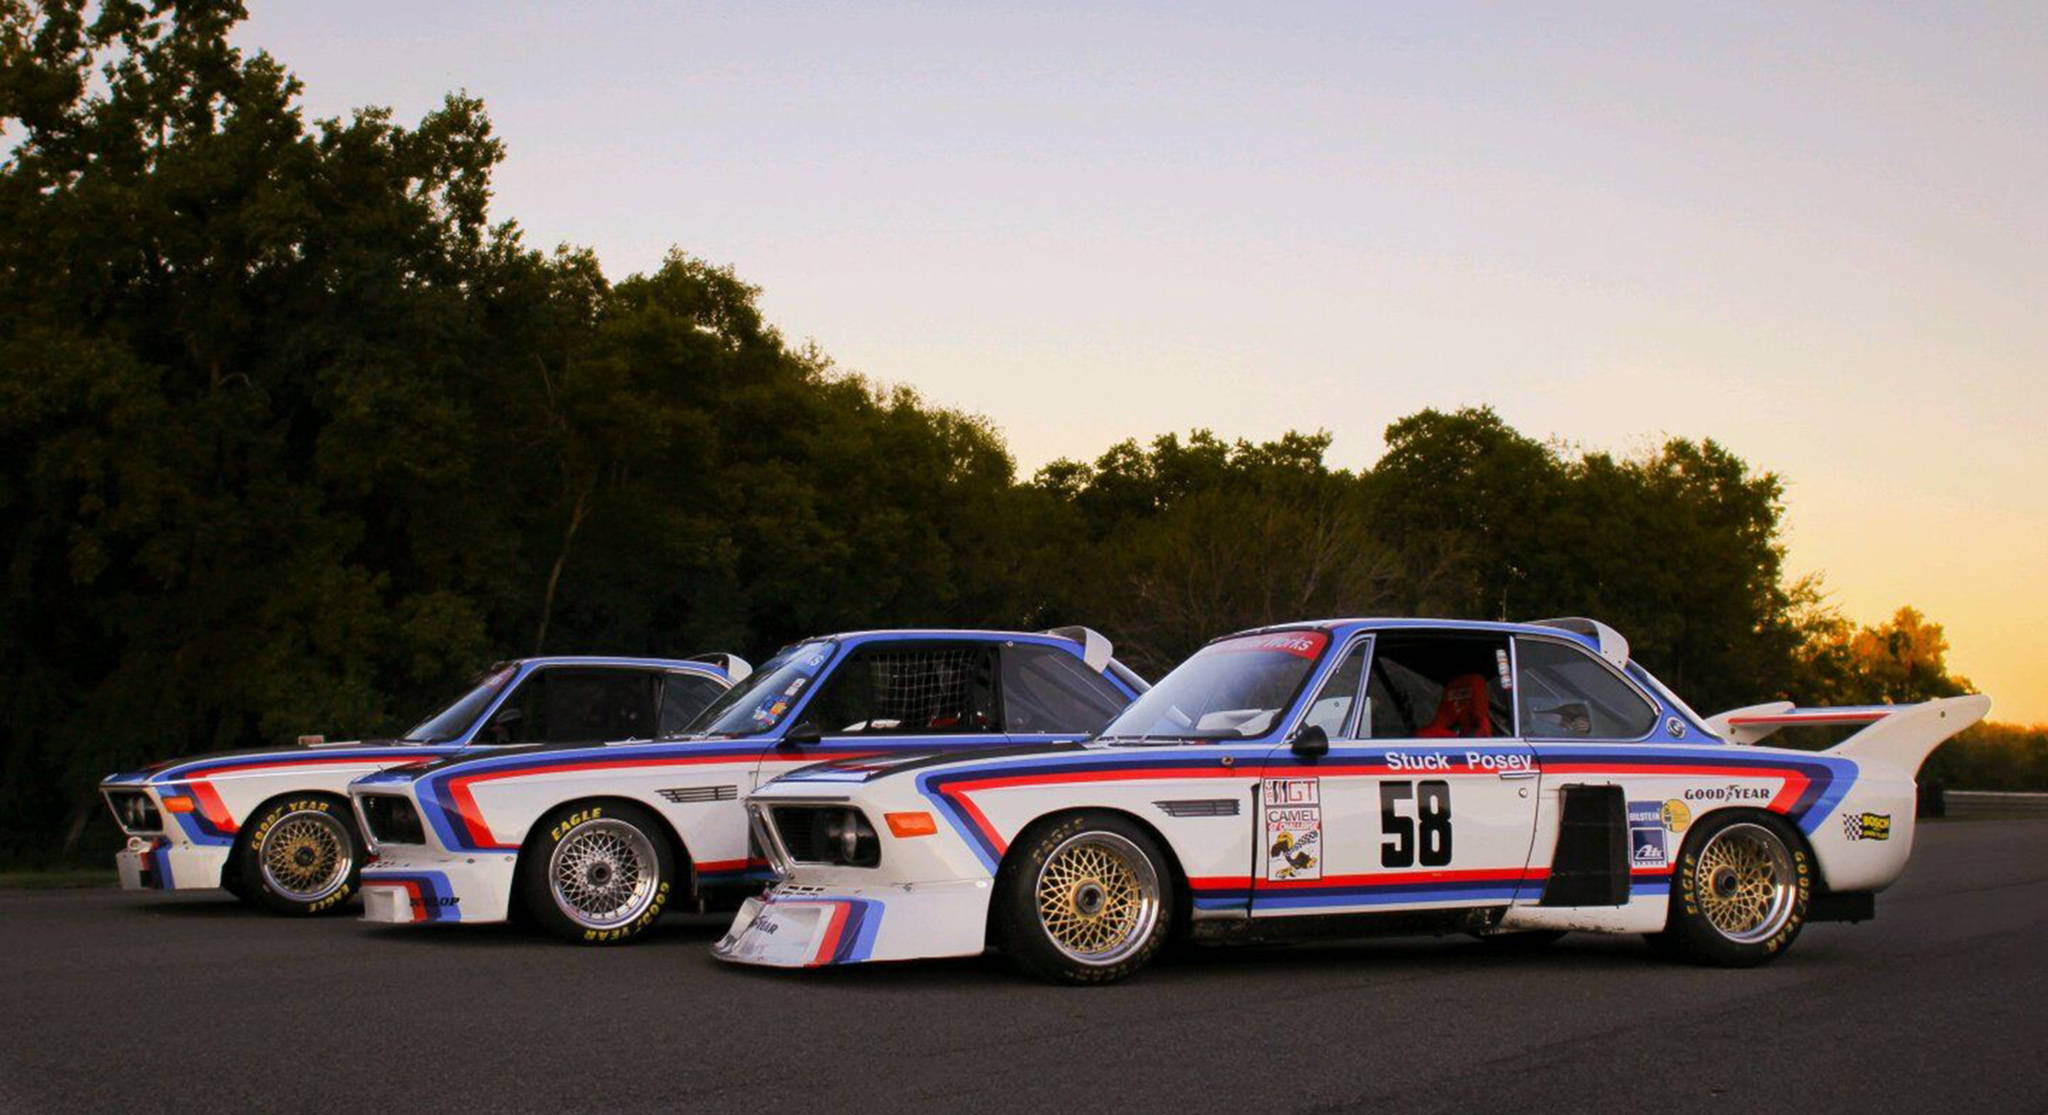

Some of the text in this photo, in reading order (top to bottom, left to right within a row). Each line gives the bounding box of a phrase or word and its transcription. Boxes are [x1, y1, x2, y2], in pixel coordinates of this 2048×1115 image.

[1385, 752, 1532, 770] Stuck Posey
[1288, 781, 1317, 801] GT
[551, 807, 602, 841] EAGLE
[1268, 810, 1319, 822] CAMEL
[1379, 780, 1452, 868] 58
[1629, 811, 1660, 821] BILSTEIN
[1033, 818, 1084, 865] EAGLE
[1682, 854, 1699, 914] EAGLE
